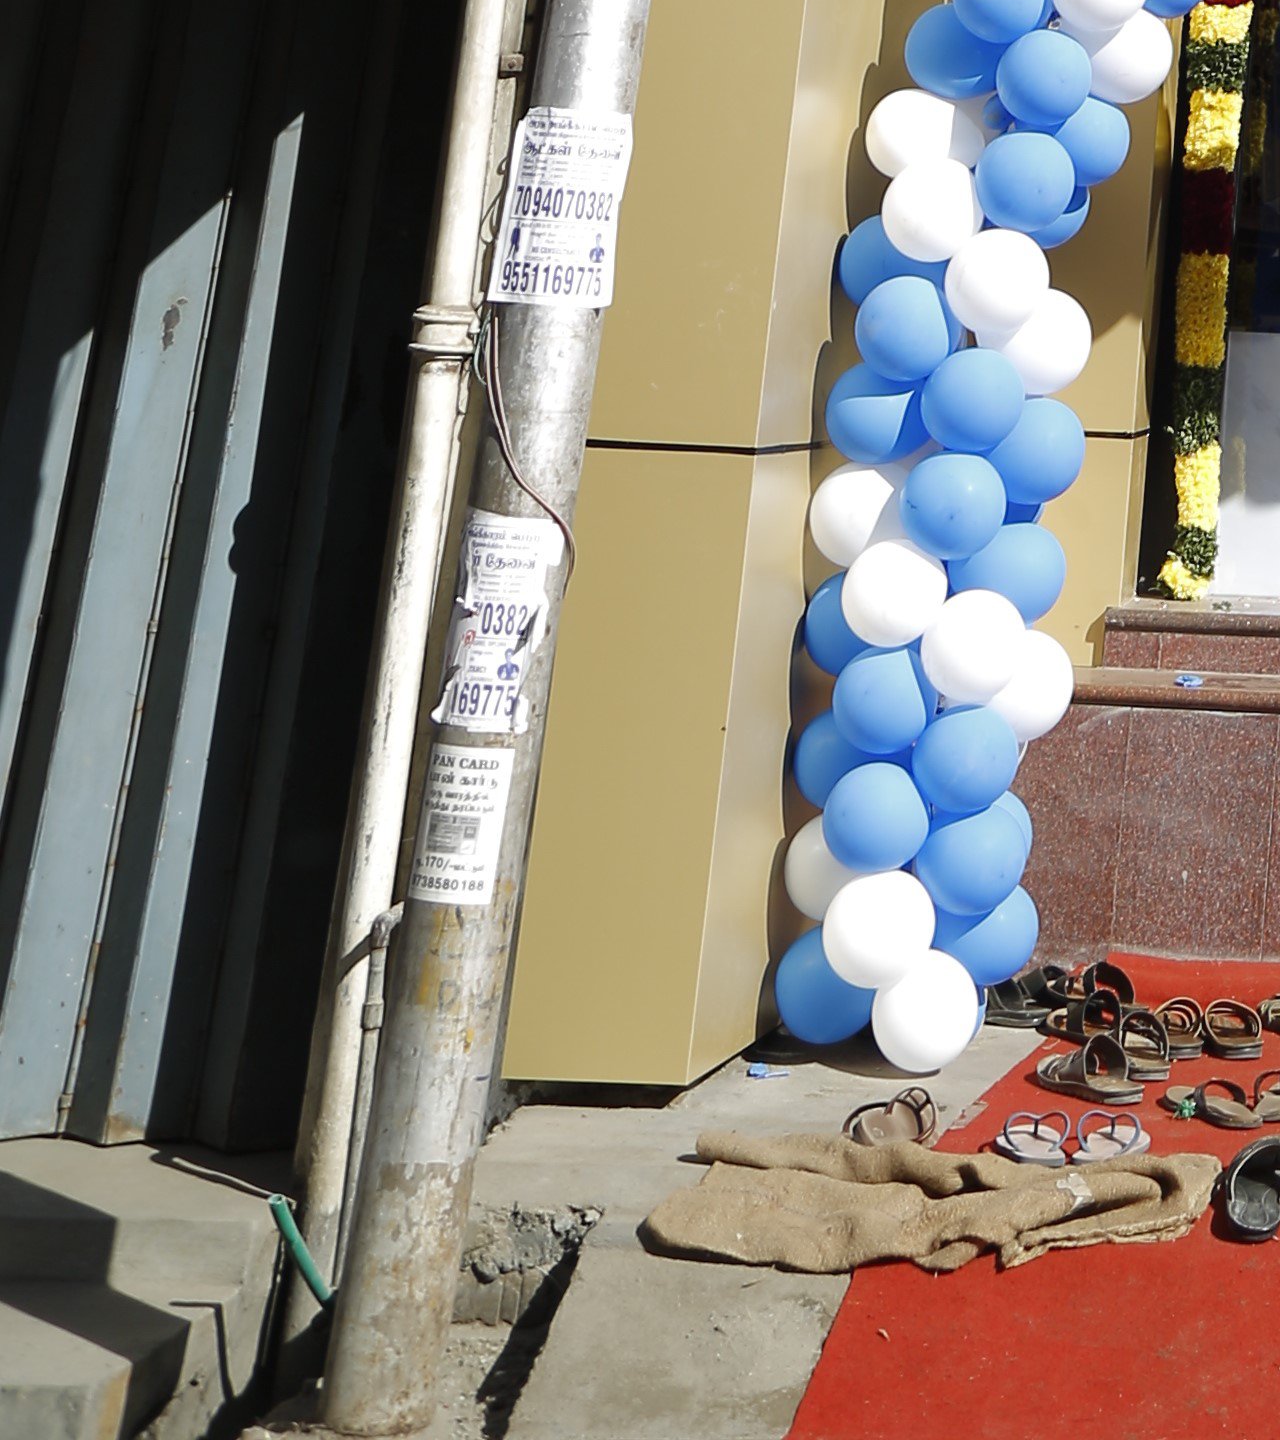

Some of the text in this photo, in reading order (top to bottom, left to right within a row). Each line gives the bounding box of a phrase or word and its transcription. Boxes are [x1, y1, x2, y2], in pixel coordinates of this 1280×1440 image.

[514, 185, 613, 222] 7094070382
[501, 260, 603, 297] 9551169775
[432, 752, 499, 770] PAN CARD
